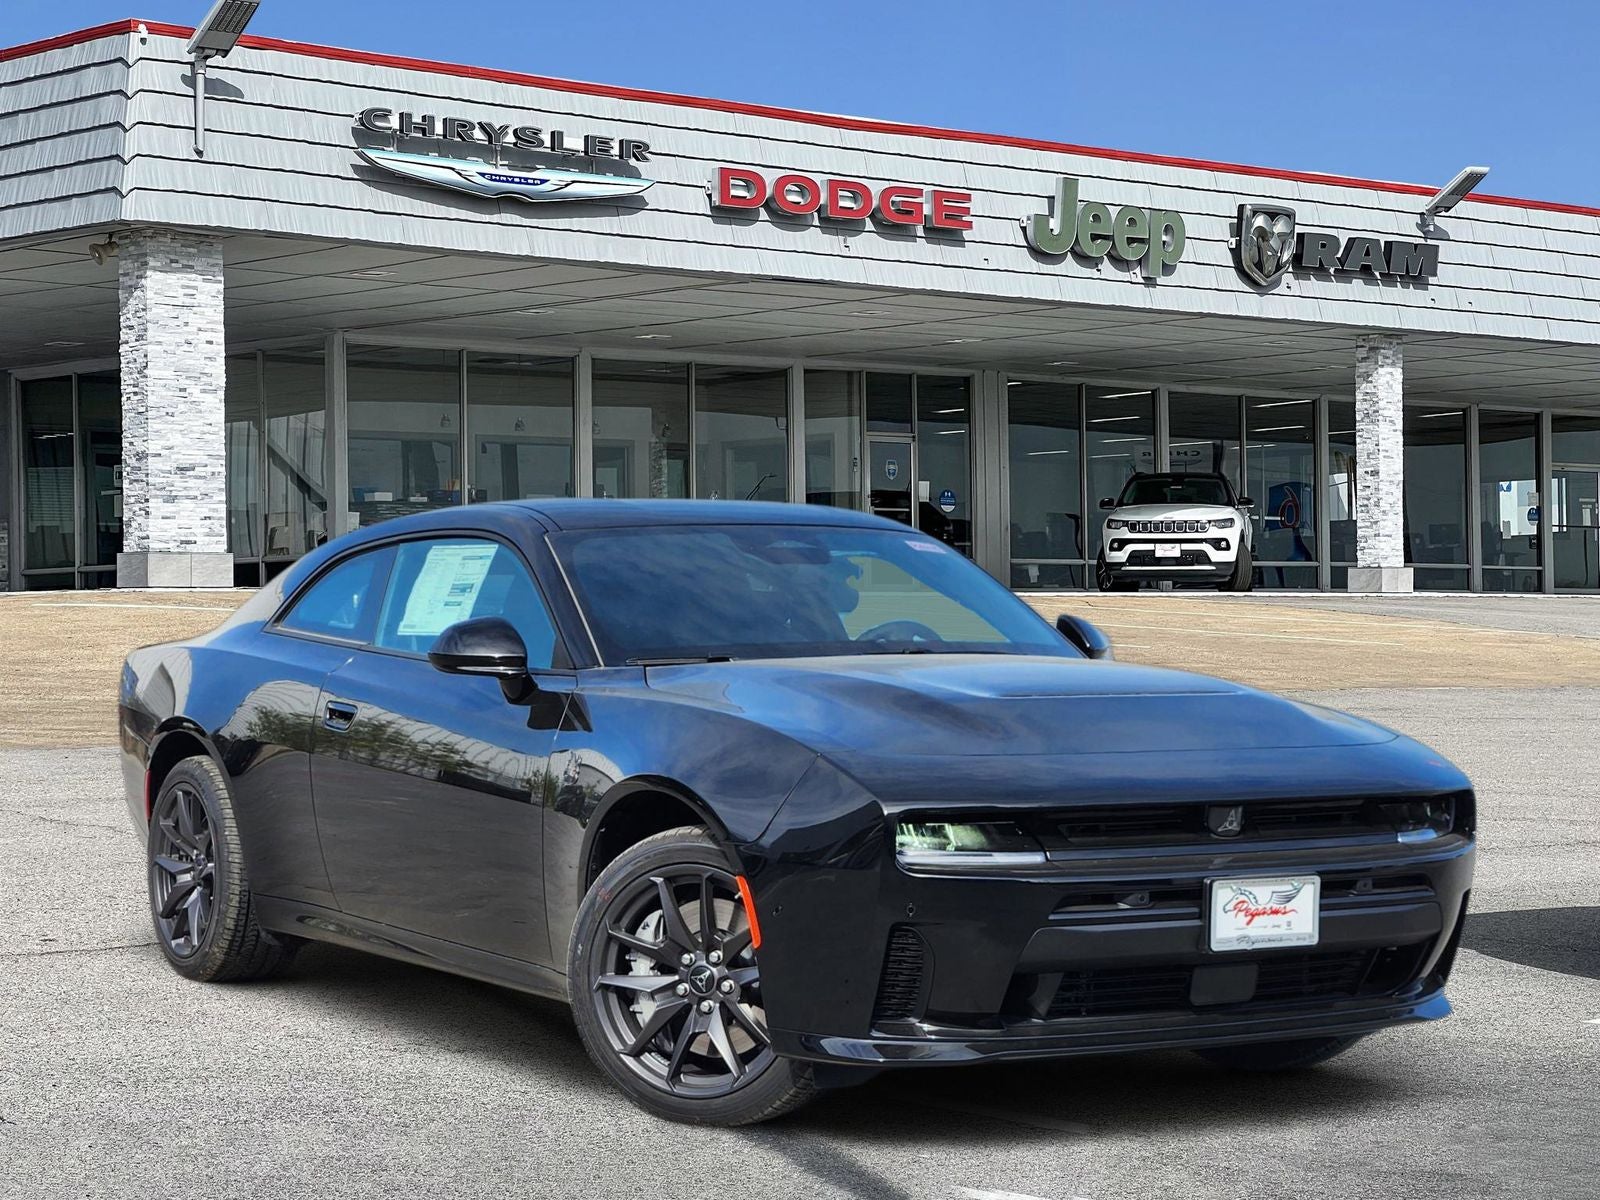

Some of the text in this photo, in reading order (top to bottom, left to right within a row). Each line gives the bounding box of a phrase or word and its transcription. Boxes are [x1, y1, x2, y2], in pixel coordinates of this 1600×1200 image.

[357, 106, 651, 162] CHRYSLER
[484, 174, 541, 185] CHRYSLER
[712, 167, 973, 230] DODGE
[1027, 177, 1186, 278] Jeep
[1302, 232, 1439, 276] RAM
[1233, 900, 1297, 926] Pegasus
